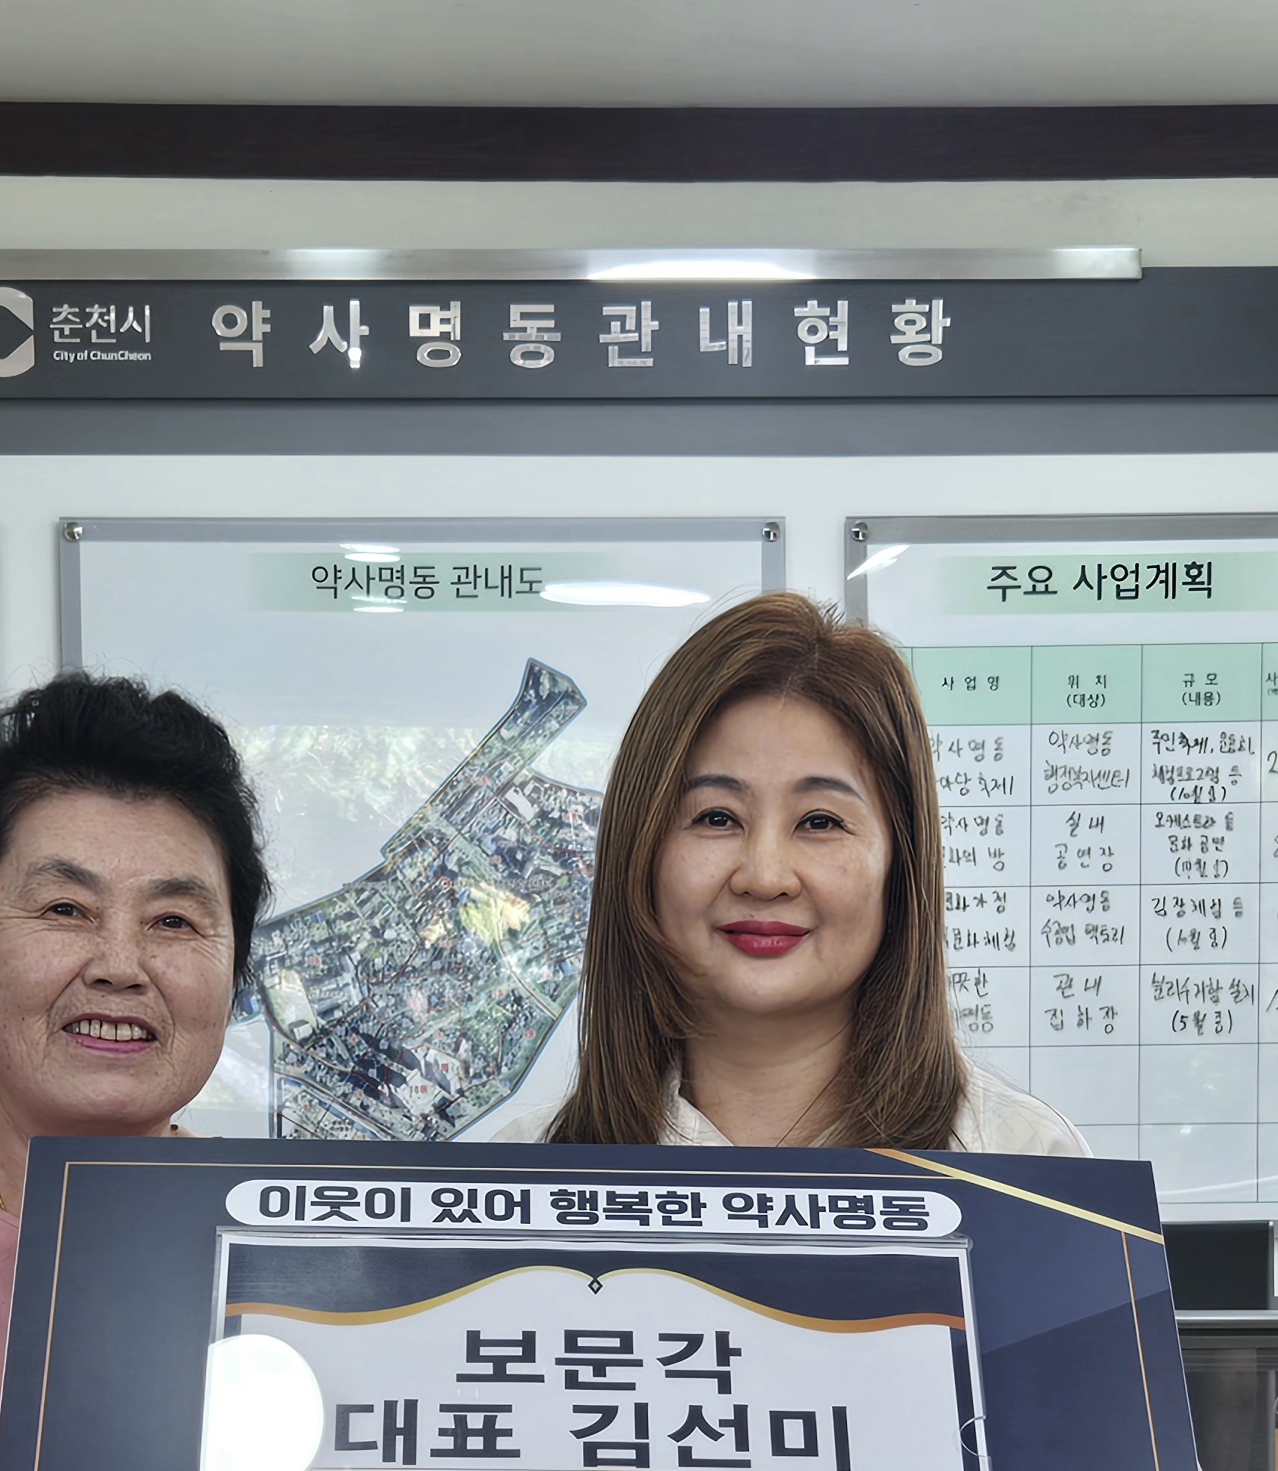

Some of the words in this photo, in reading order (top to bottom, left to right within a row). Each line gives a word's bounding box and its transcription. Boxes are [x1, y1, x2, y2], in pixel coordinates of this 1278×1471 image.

[49, 304, 152, 344] 춘천시
[53, 350, 76, 363] City
[311, 564, 440, 600] 약사명동
[450, 564, 543, 599] 관내도
[986, 564, 1058, 602] 주요
[1073, 560, 1215, 601] 사업계획
[1182, 692, 1221, 707] (내용)
[259, 1184, 414, 1226] 이웃이
[429, 1186, 533, 1227] 있어
[549, 1188, 707, 1230] 행복한
[722, 1190, 932, 1233] 약사명동
[455, 1328, 744, 1394] 보문각
[332, 1399, 522, 1468] 대표
